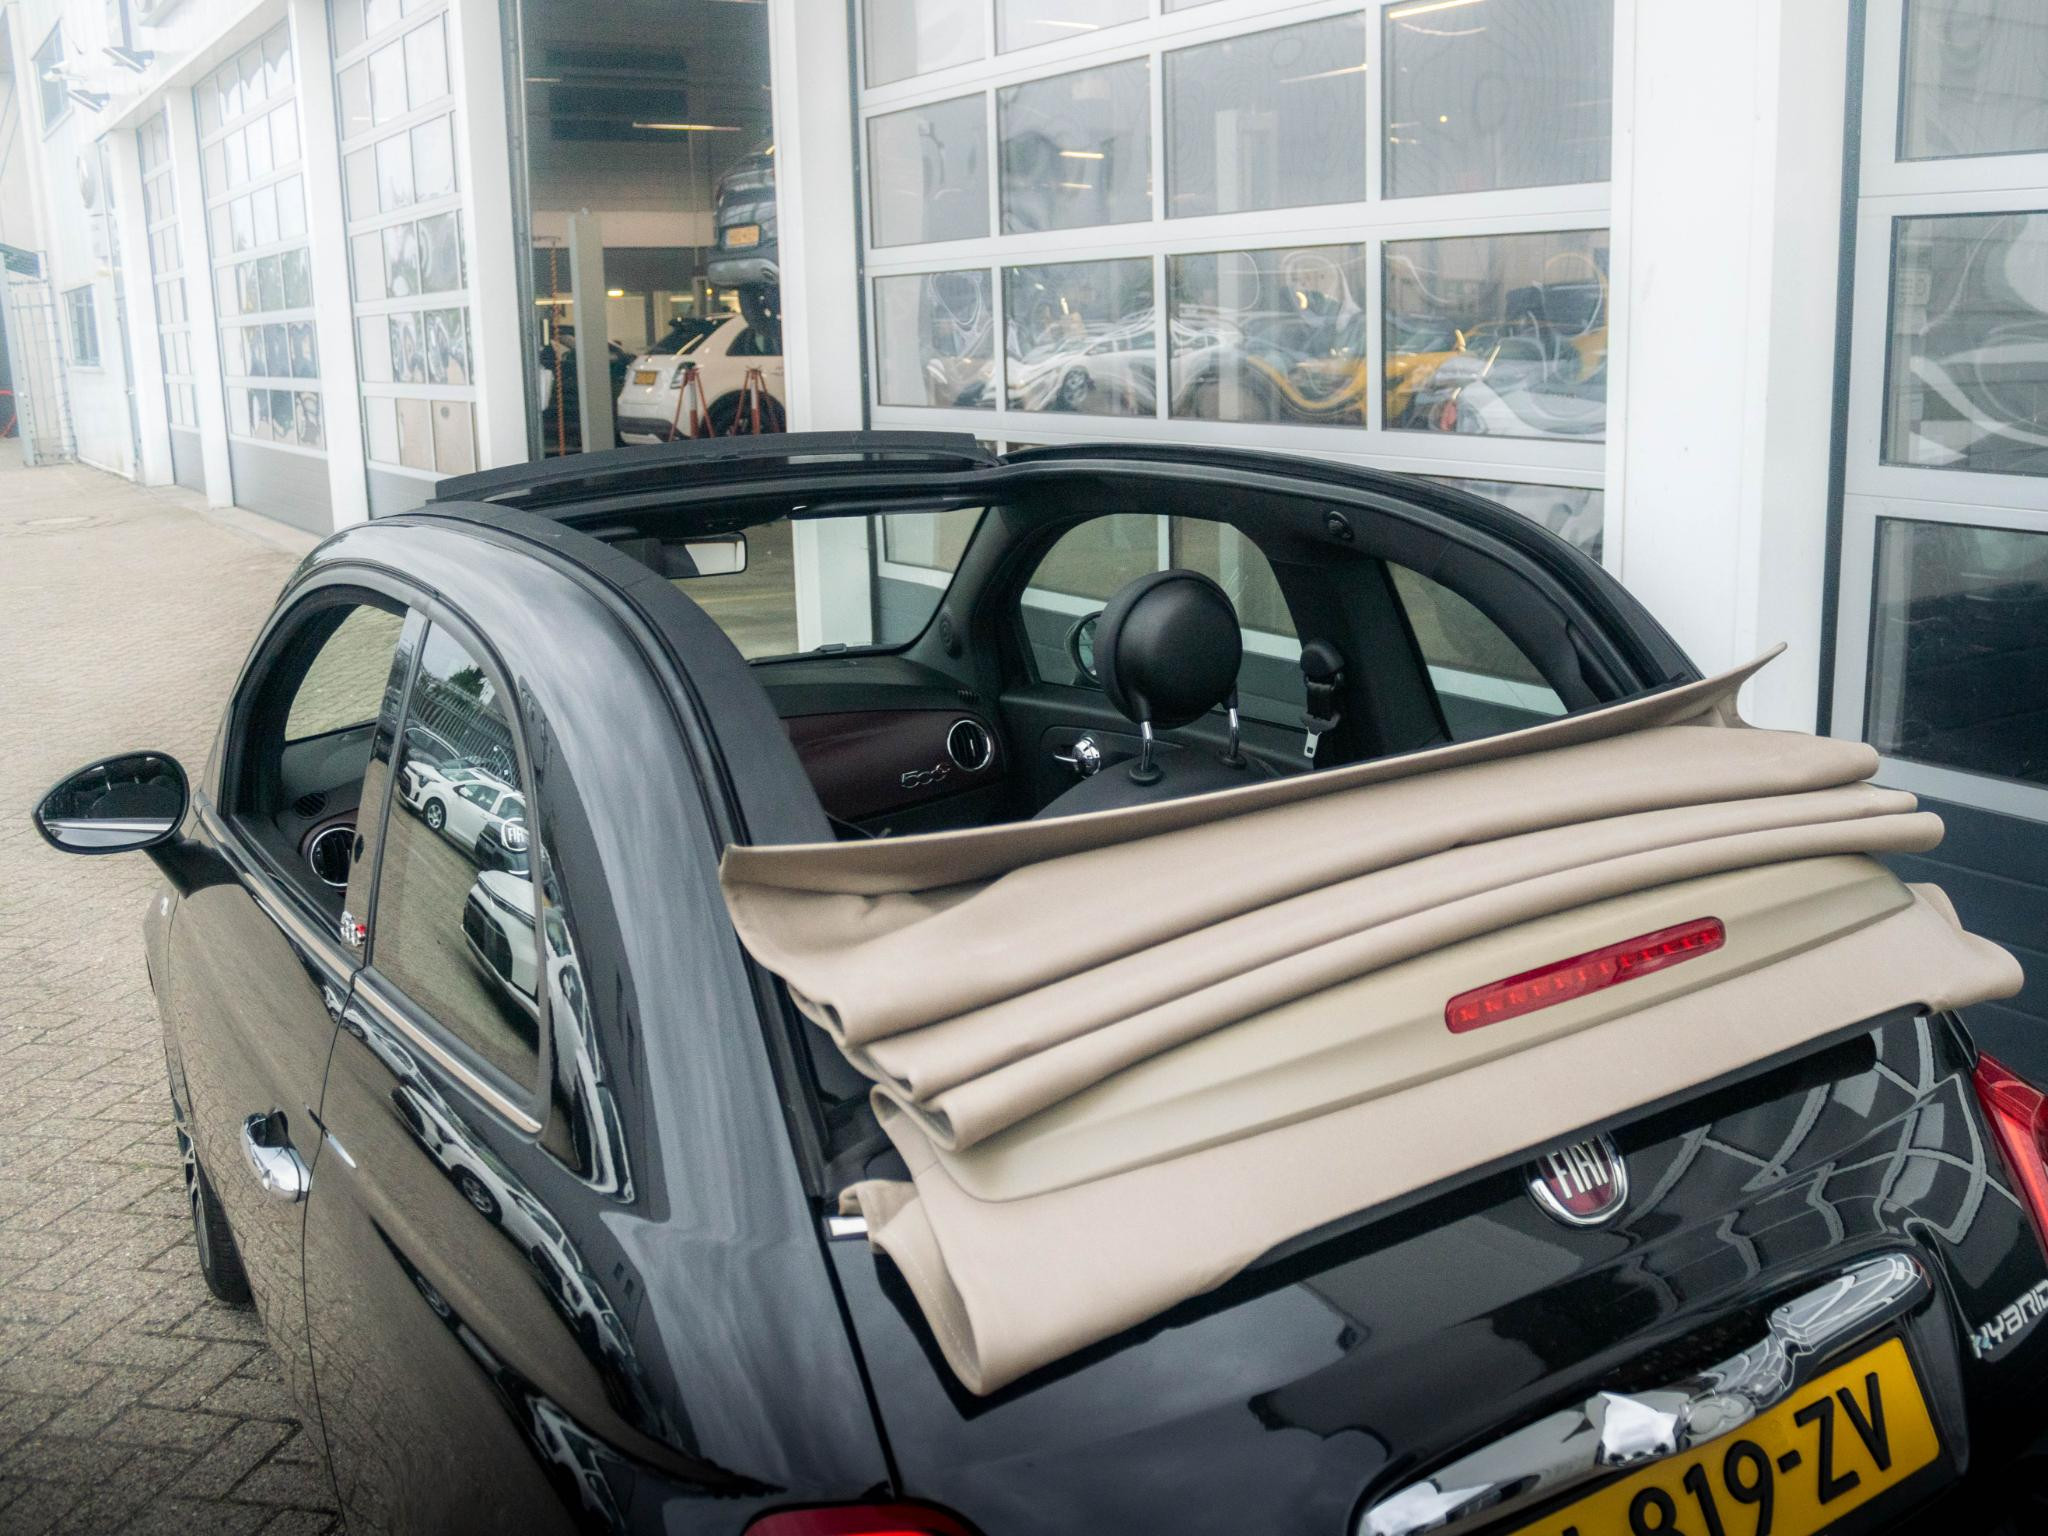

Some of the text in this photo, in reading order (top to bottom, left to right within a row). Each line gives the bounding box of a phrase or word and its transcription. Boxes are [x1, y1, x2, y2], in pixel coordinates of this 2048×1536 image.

[507, 827, 529, 842] FIA
[1546, 1136, 1609, 1199] FIAT
[1562, 1372, 1892, 1536] 819-ZV
